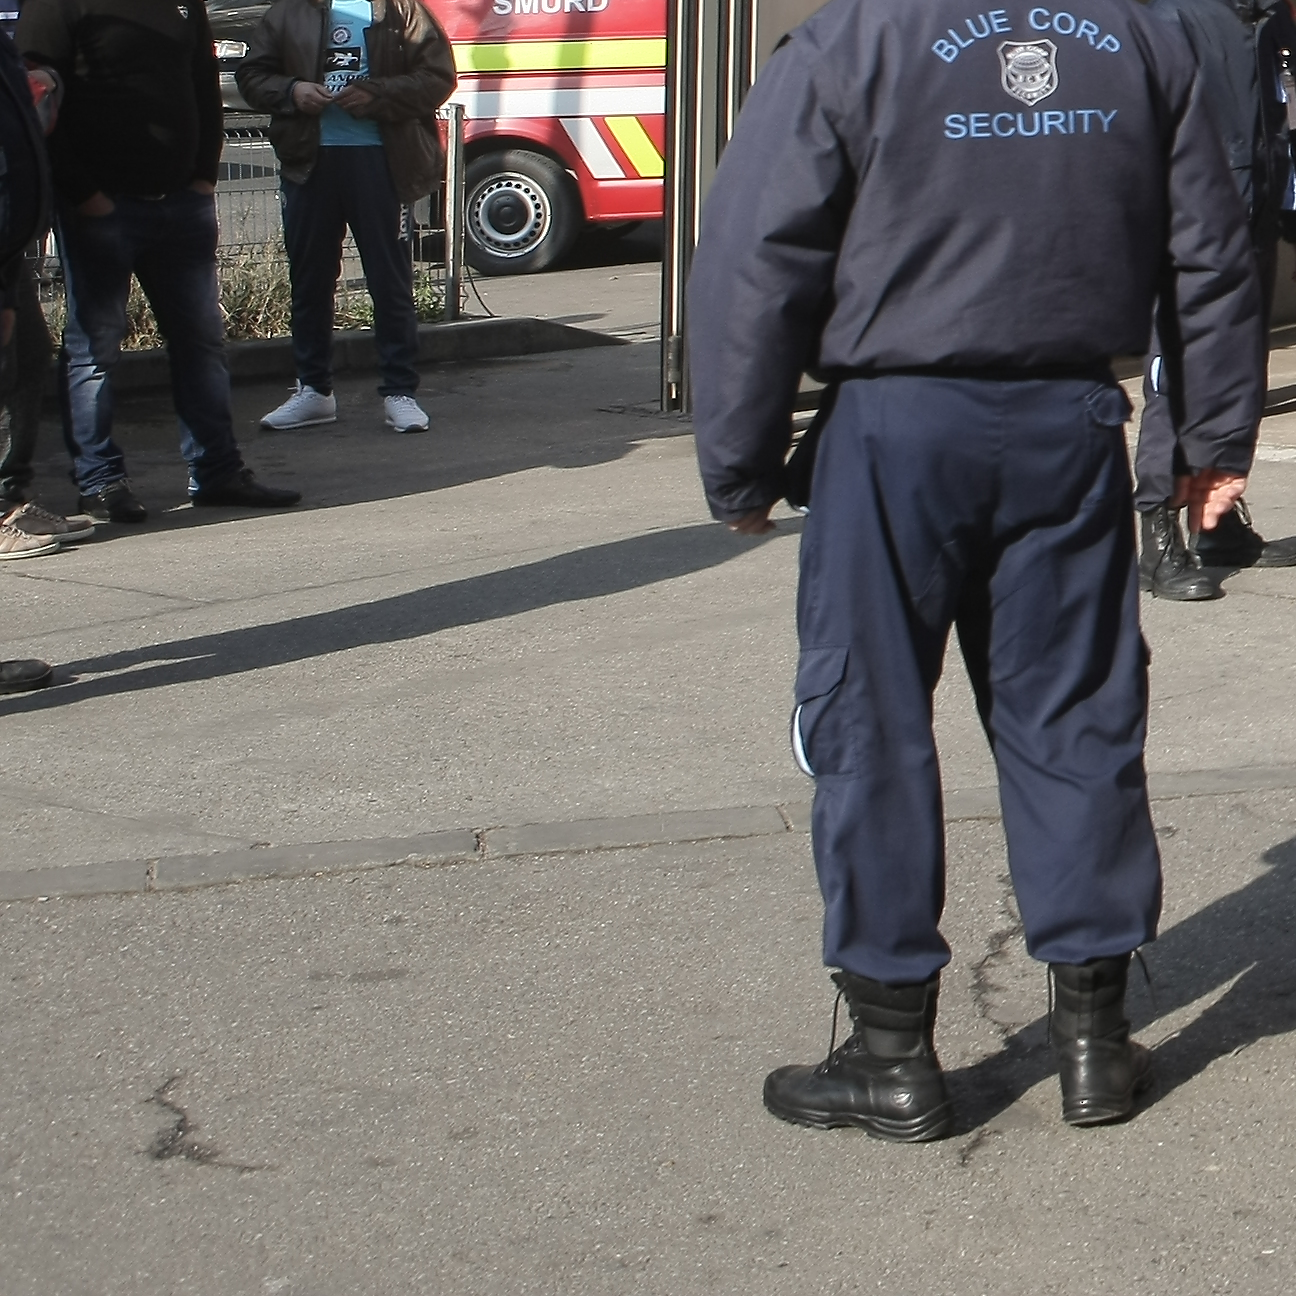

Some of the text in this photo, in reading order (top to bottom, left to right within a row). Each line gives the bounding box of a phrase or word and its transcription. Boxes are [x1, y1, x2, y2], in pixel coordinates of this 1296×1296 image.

[930, 7, 1122, 64] BLUE CORP
[943, 108, 1118, 140] SECURITY
